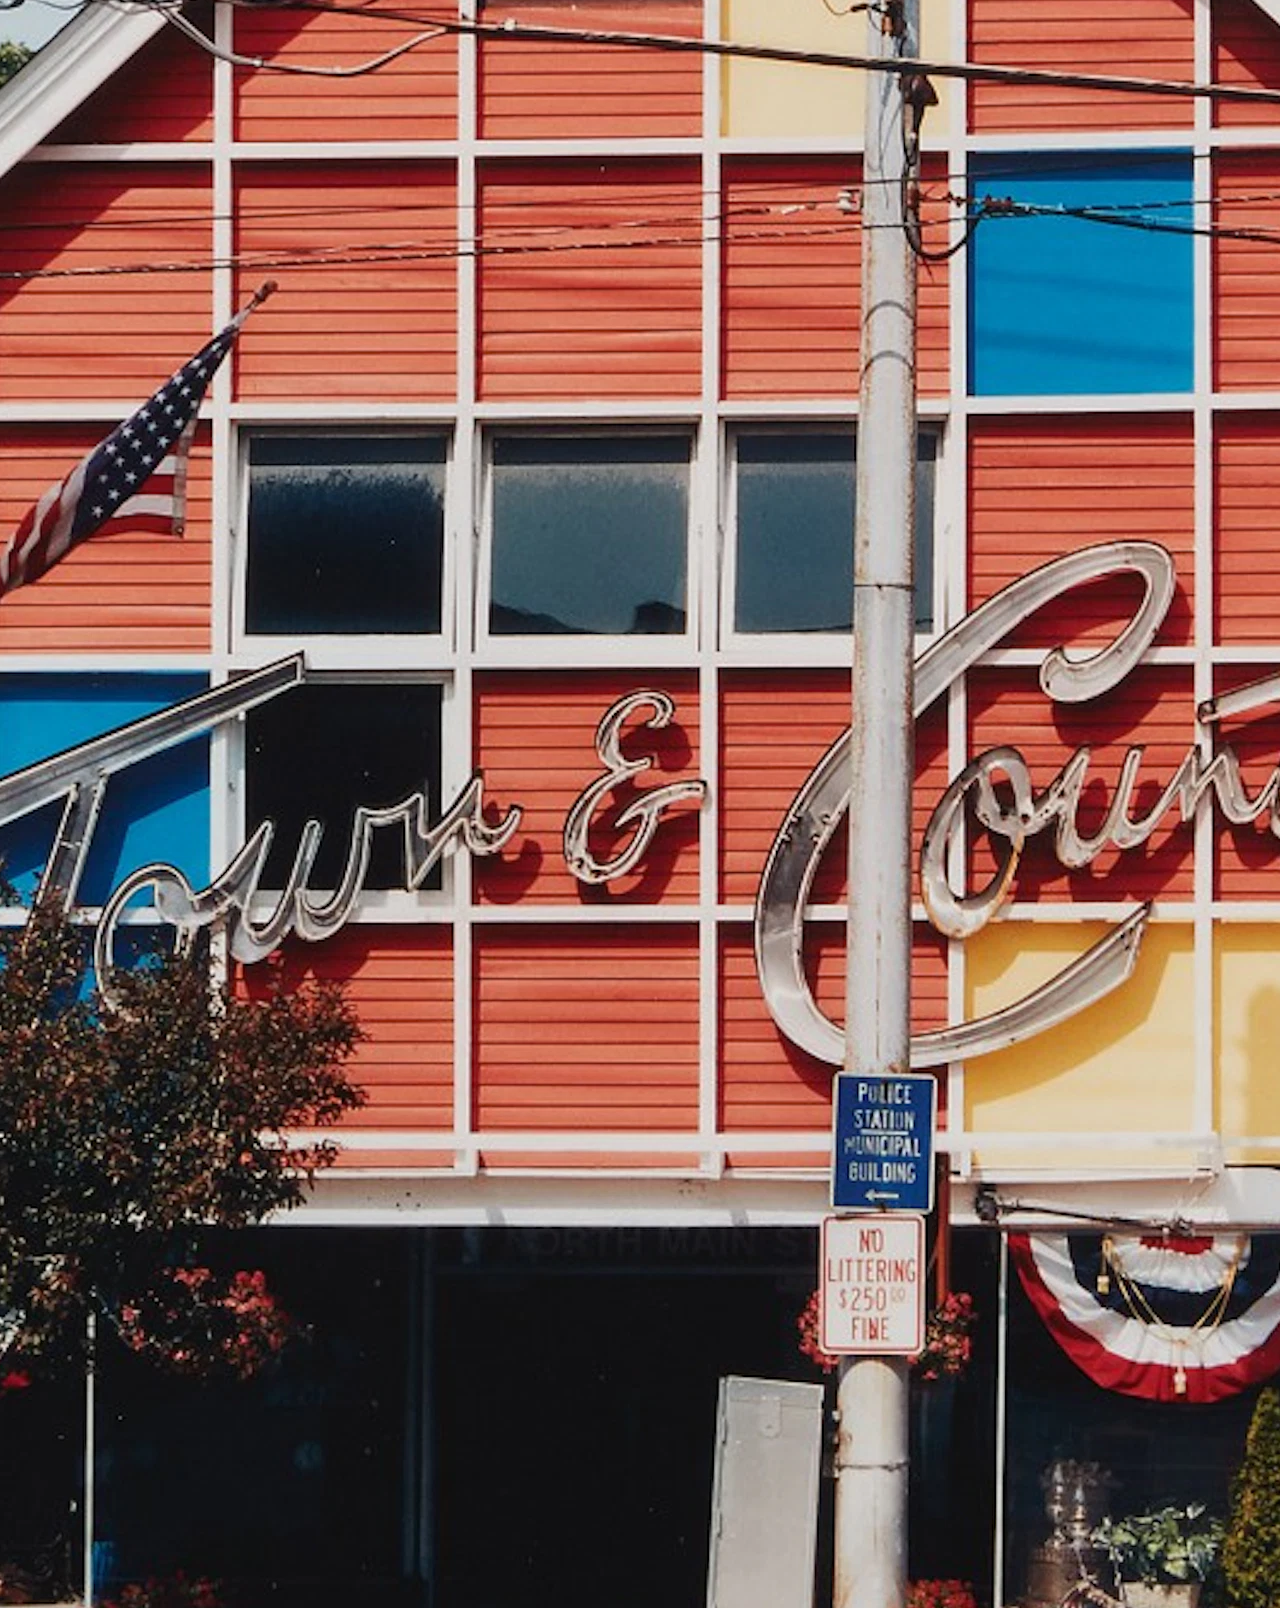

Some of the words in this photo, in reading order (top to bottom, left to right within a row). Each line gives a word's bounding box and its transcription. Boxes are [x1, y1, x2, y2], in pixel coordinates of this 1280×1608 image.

[564, 688, 708, 885] &
[858, 1082, 914, 1105] POLICE
[853, 1108, 916, 1131] STATION
[843, 1135, 921, 1158] MUNICIPAL
[848, 1161, 917, 1185] BUILDING
[859, 1228, 885, 1253] NO
[827, 1258, 916, 1283] LITTERING
[852, 1316, 890, 1340] FINE
